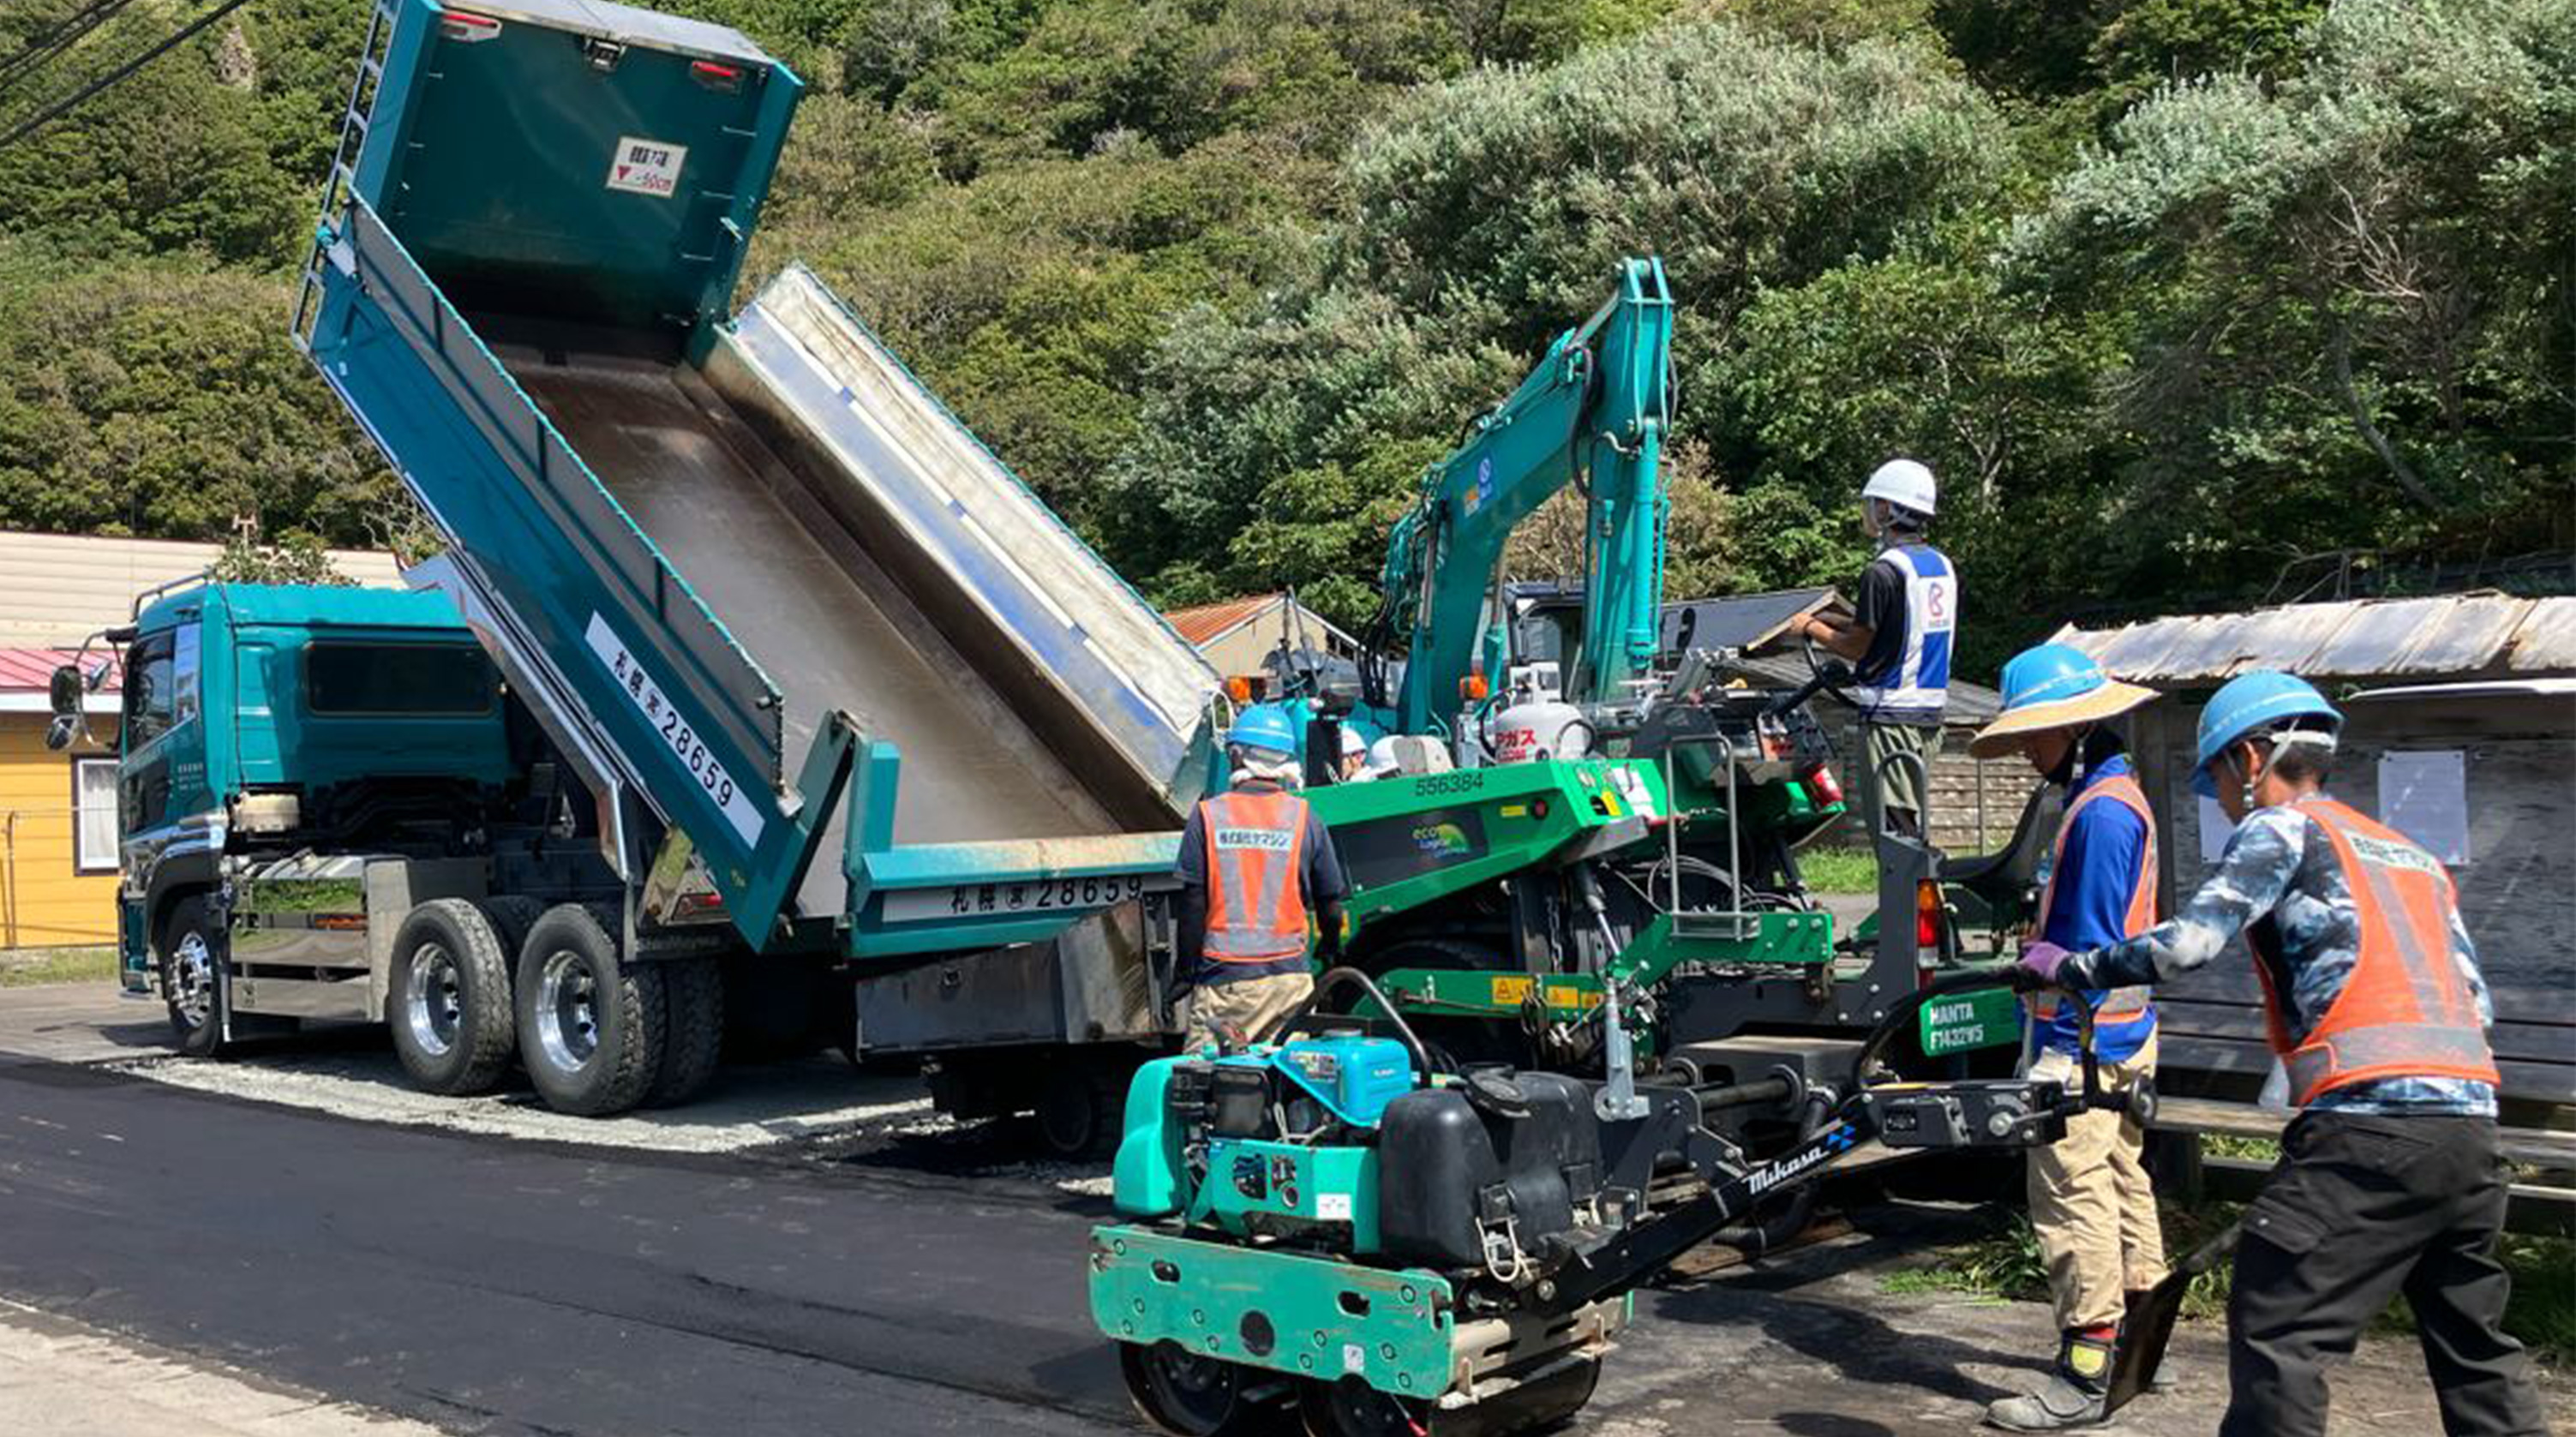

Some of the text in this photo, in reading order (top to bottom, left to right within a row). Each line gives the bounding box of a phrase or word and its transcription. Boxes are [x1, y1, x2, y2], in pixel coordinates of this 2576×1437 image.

[662, 710, 734, 807] 28659
[1416, 773, 1484, 797] 556384
[1036, 875, 1142, 908] 28659
[1930, 1001, 1974, 1027] HANTA
[1740, 1146, 1830, 1195] Mikasa
